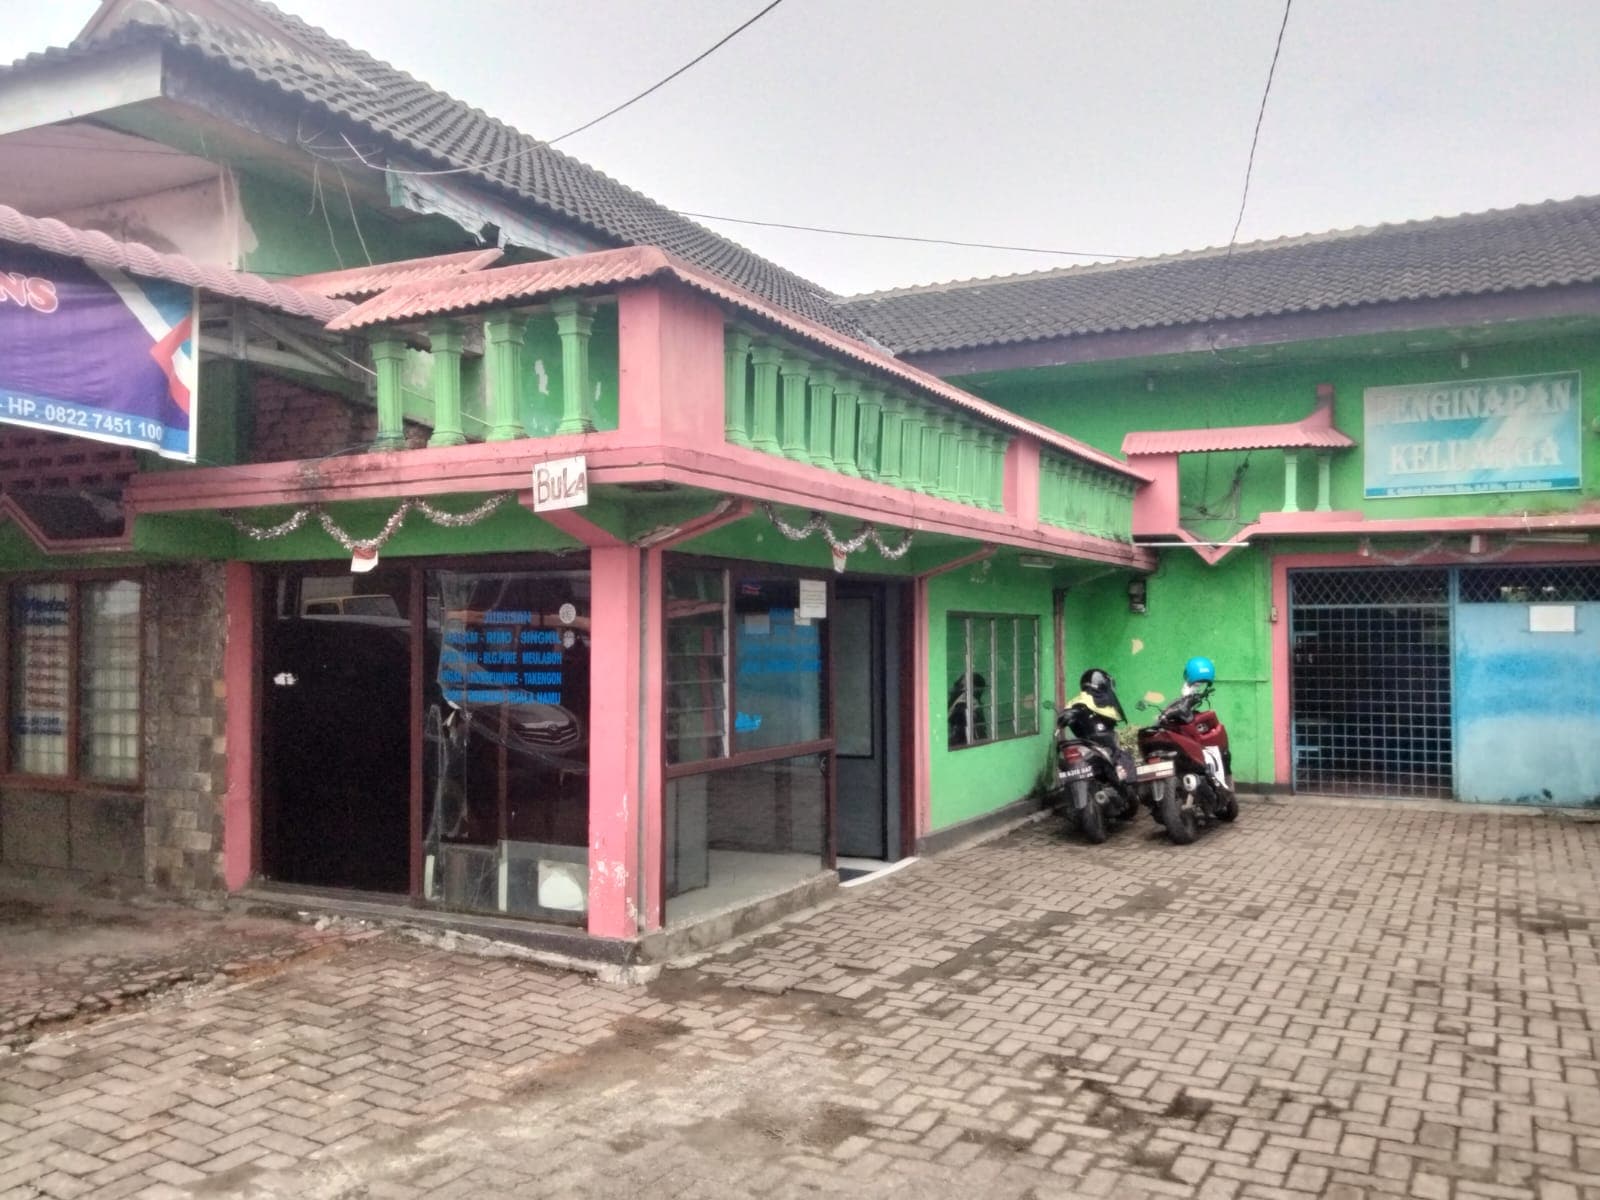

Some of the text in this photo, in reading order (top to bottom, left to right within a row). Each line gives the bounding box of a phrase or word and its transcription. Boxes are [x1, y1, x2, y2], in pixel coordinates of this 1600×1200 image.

[1376, 380, 1572, 424] PENGINAPAN
[45, 404, 88, 427] 0822
[92, 413, 133, 435] 7451
[486, 631, 513, 645] RIMO
[520, 632, 562, 645] SINGKIL
[522, 652, 562, 665] MEULABOH
[524, 672, 562, 685] TAKENGON
